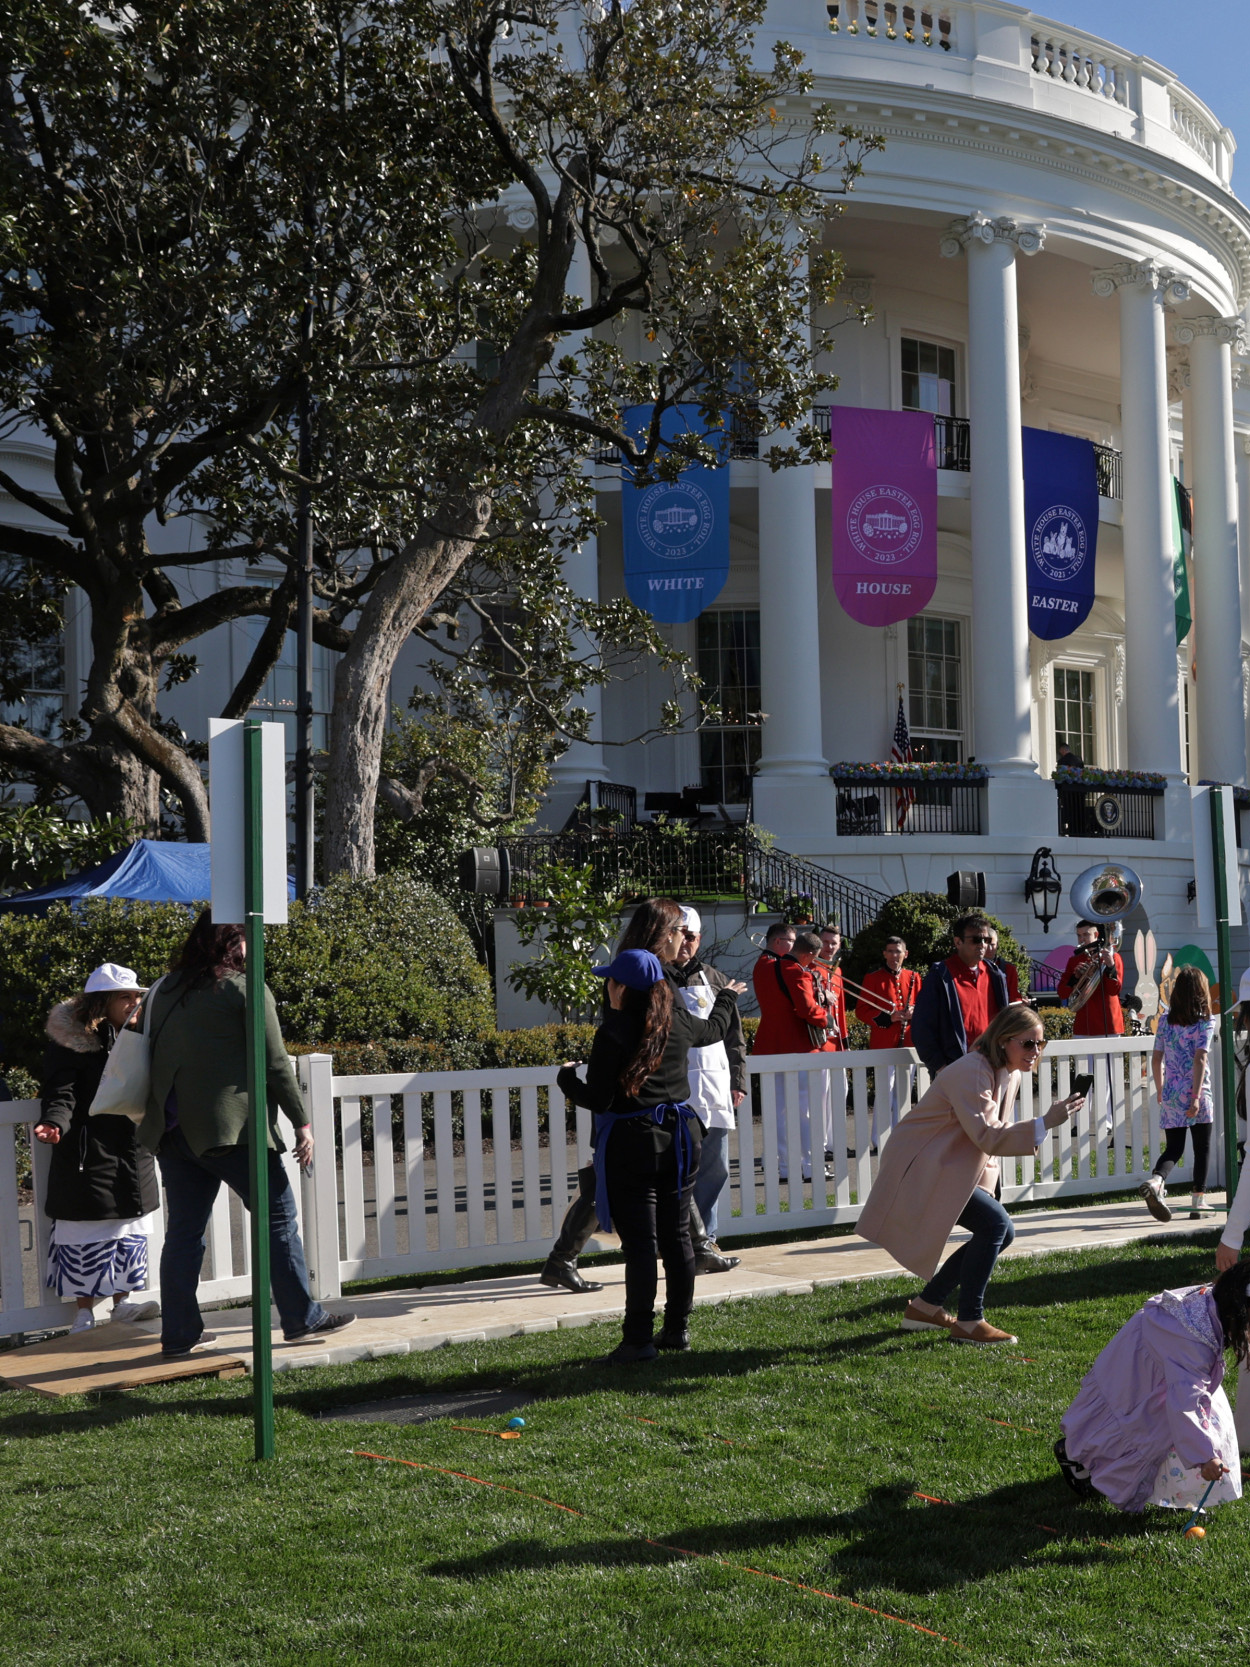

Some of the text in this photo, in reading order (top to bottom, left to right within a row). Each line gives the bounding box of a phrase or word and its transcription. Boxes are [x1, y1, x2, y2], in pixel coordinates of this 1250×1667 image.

[641, 484, 666, 513] HOUSE
[700, 499, 711, 520] EGG
[850, 487, 920, 553] WHITE HOUSE EASTER EGG ROLL
[1036, 509, 1057, 533] HOUSE
[1058, 508, 1082, 530] EASTER
[639, 516, 656, 549] WHITE
[693, 522, 711, 546] ROLL
[665, 548, 687, 556] 2023
[875, 553, 896, 561] 2023
[1034, 534, 1045, 568] WHITE
[1071, 550, 1084, 572] ROLL
[648, 577, 705, 591] WHITE
[1050, 570, 1065, 578] 2023
[856, 582, 912, 595] HOUSE
[1032, 595, 1079, 613] EASTER
